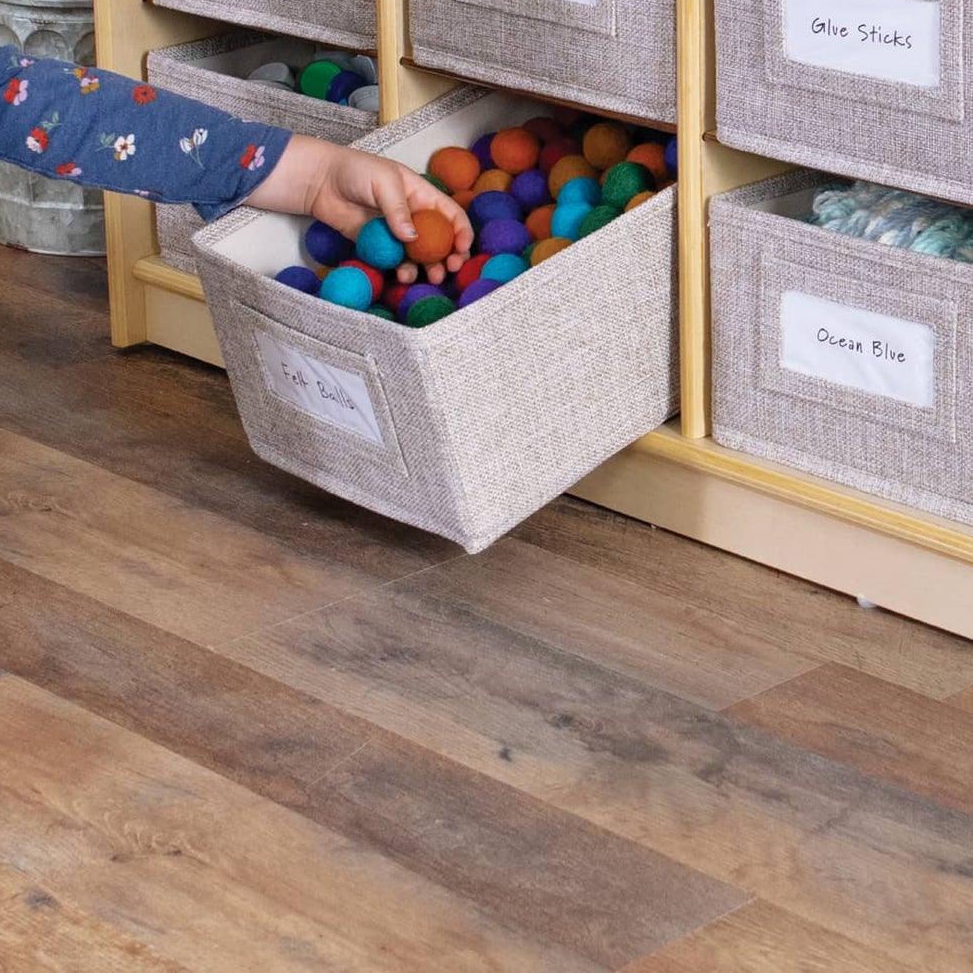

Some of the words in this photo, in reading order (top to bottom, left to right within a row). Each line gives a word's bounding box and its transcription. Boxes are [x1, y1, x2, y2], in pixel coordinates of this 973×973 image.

[811, 16, 849, 38] Glue
[857, 23, 913, 49] Sticks
[816, 327, 863, 354] Ocean
[872, 340, 907, 363] Blue
[280, 360, 309, 387] Felt
[316, 380, 355, 410] Balls
